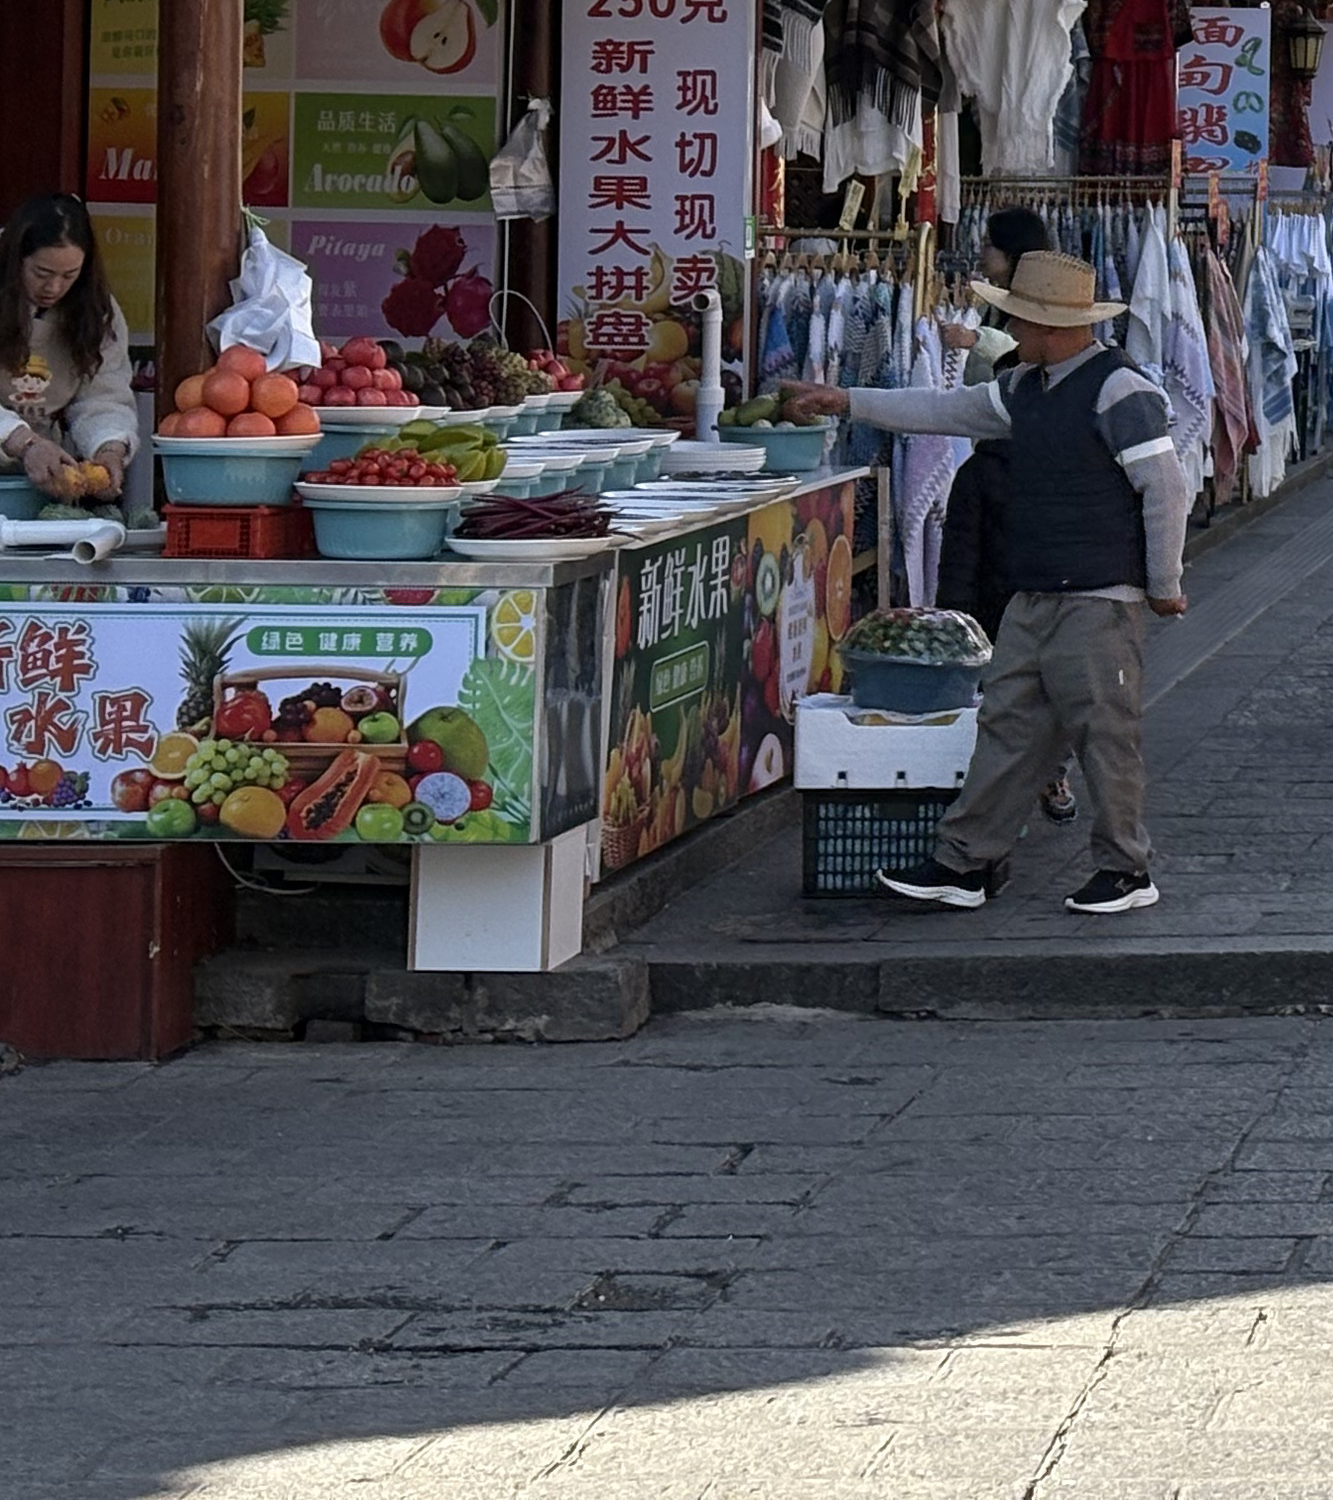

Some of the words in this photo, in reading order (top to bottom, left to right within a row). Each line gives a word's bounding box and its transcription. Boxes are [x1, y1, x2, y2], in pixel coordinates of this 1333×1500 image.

[316, 108, 396, 133] 品质生活
[99, 146, 156, 182] Ma
[304, 163, 417, 194] Avocado
[586, 38, 656, 350] 新鲜水果大拼盘
[672, 69, 719, 303] 现切现卖
[308, 234, 387, 263] Pitaya
[637, 534, 731, 651] 新鲜水果
[261, 630, 304, 652] 绿色
[318, 632, 362, 652] 健康
[375, 632, 418, 652] 营养
[9, 690, 156, 758] 水果
